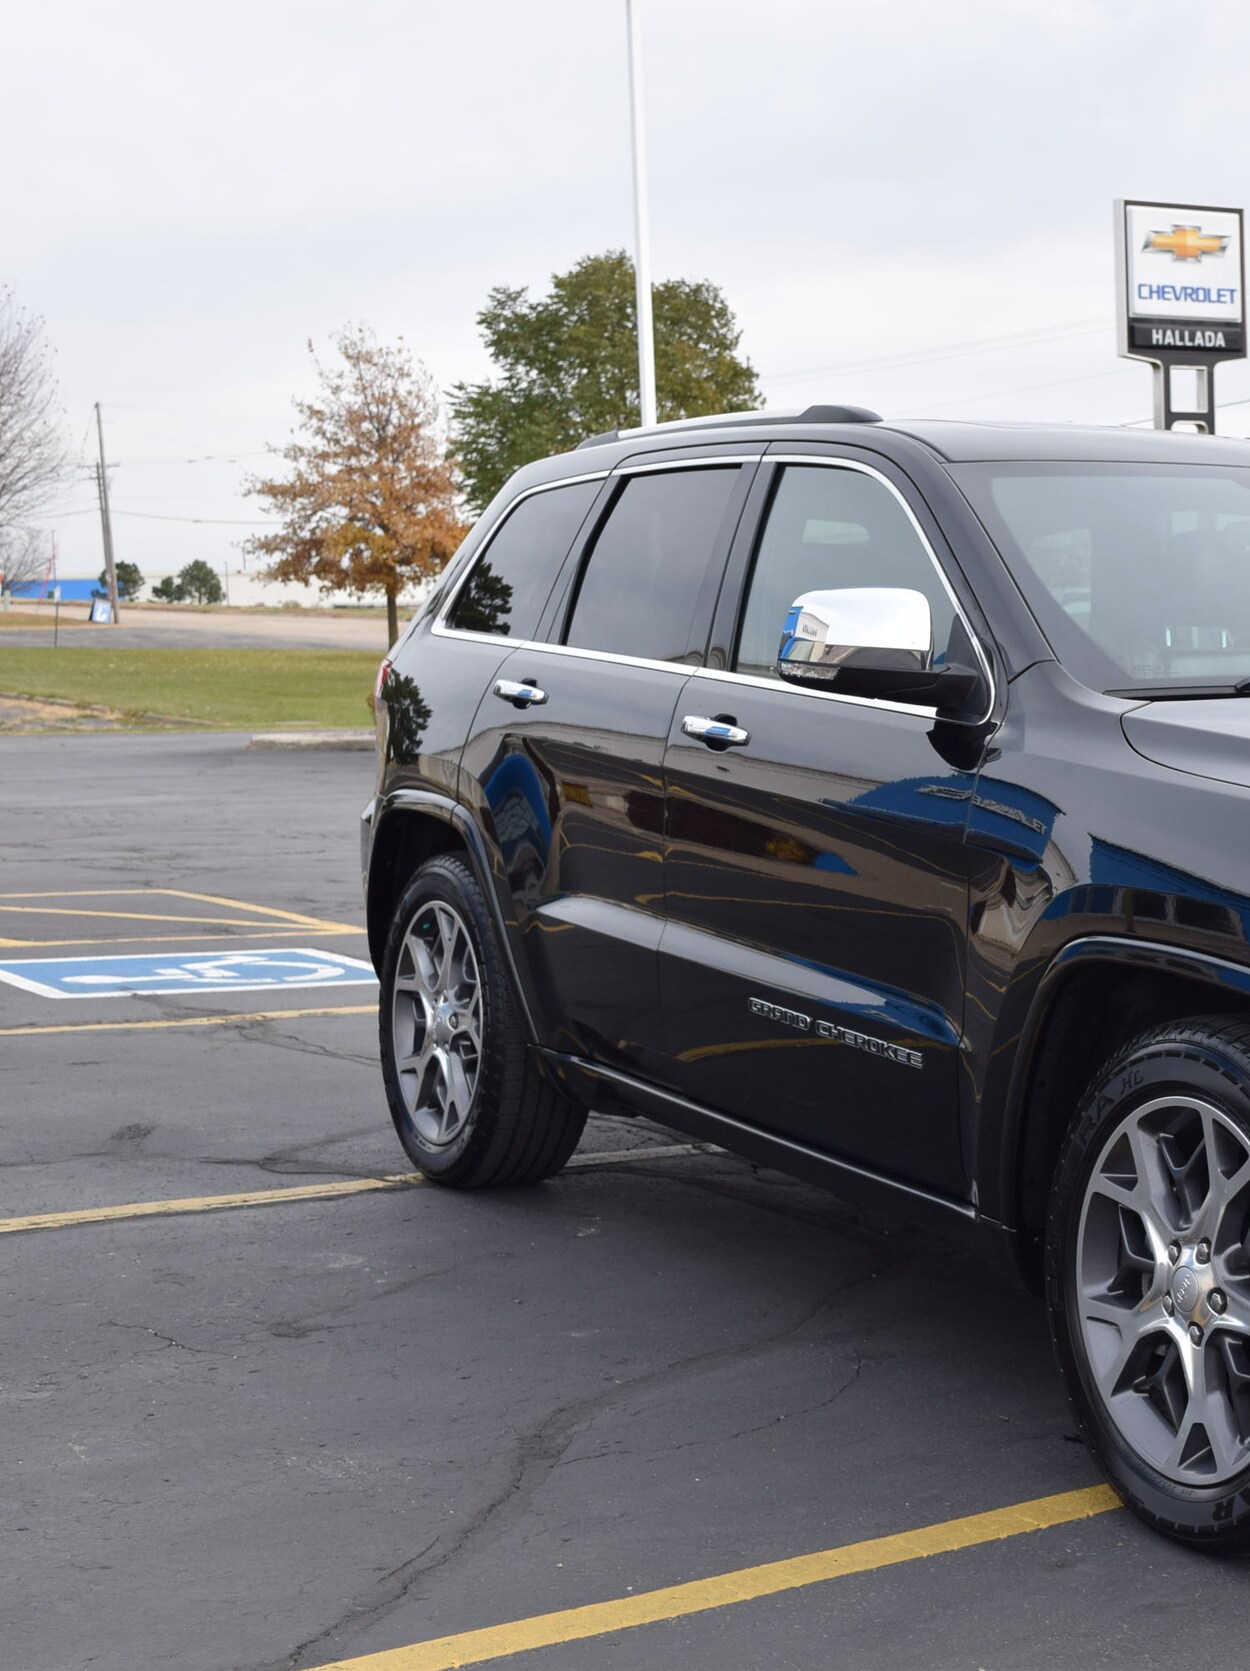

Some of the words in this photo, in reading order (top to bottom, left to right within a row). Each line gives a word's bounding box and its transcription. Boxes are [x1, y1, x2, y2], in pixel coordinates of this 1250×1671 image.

[1138, 283, 1237, 304] CHEVROLET
[1152, 328, 1226, 348] HALLADA
[749, 997, 813, 1031] GRAND
[816, 1020, 923, 1069] CHEROKEE
